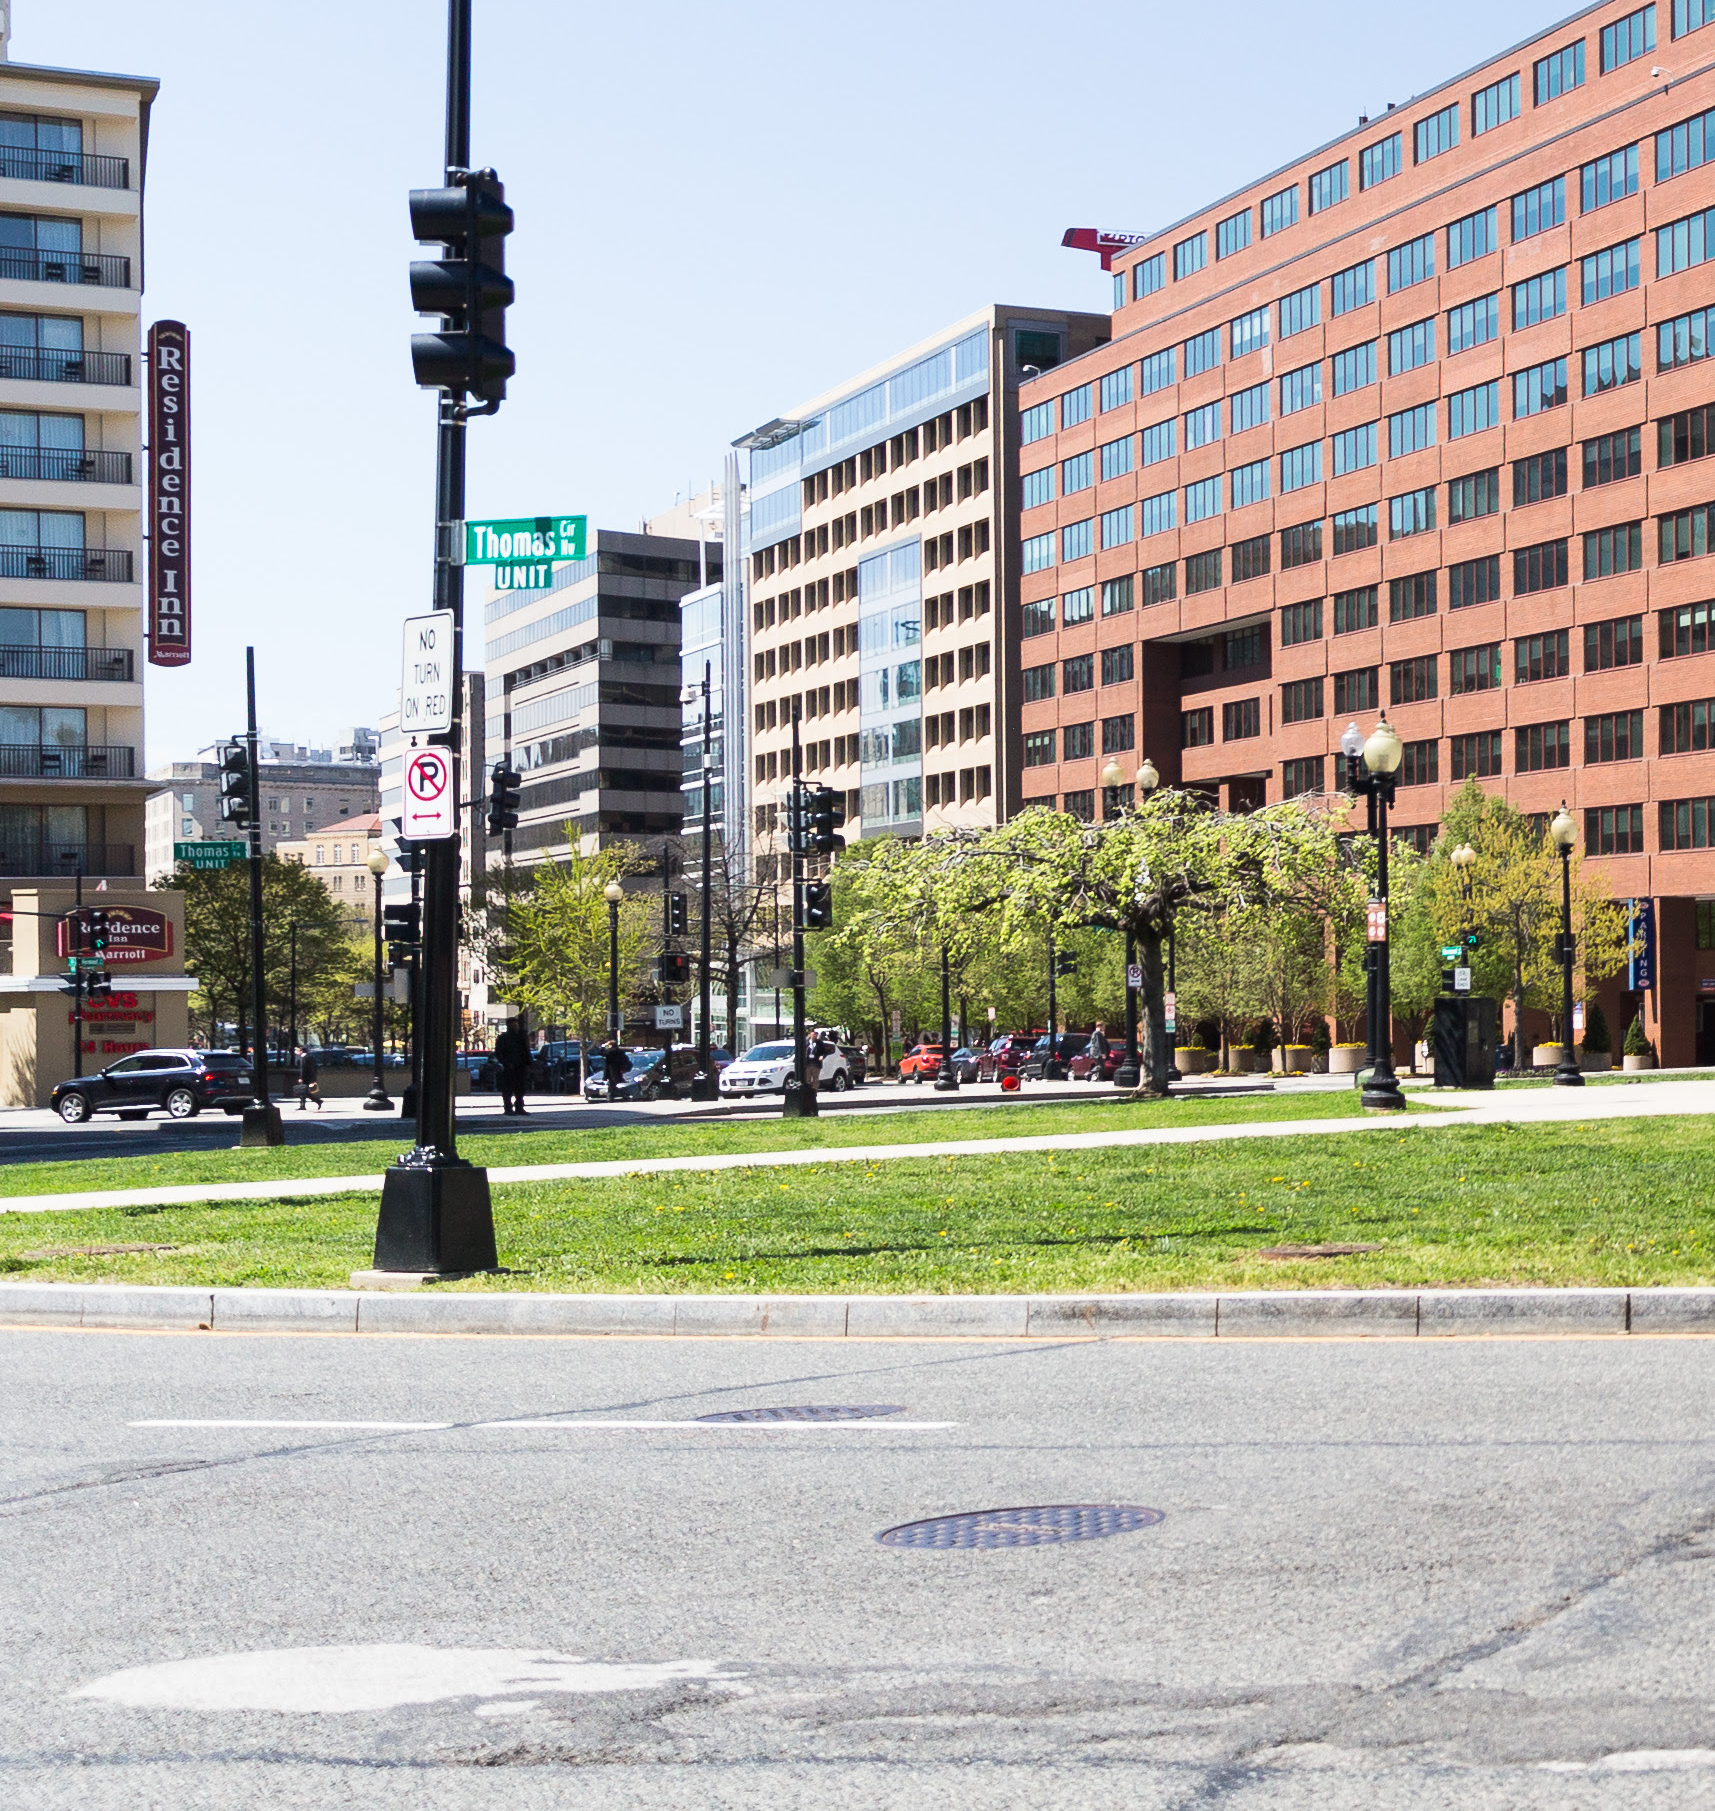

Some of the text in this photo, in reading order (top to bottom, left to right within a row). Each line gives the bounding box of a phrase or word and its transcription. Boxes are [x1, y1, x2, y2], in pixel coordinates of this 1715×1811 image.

[158, 346, 182, 637] Residence Inn
[474, 520, 576, 559] Thomas Cir
[497, 564, 548, 589] UNIT
[420, 629, 436, 650] NO
[414, 662, 441, 684] TURN
[405, 694, 446, 719] ON RED
[180, 844, 230, 858] Thomas
[196, 859, 226, 869] UNIT
[663, 1008, 675, 1017] NO
[102, 1039, 150, 1054] Hours
